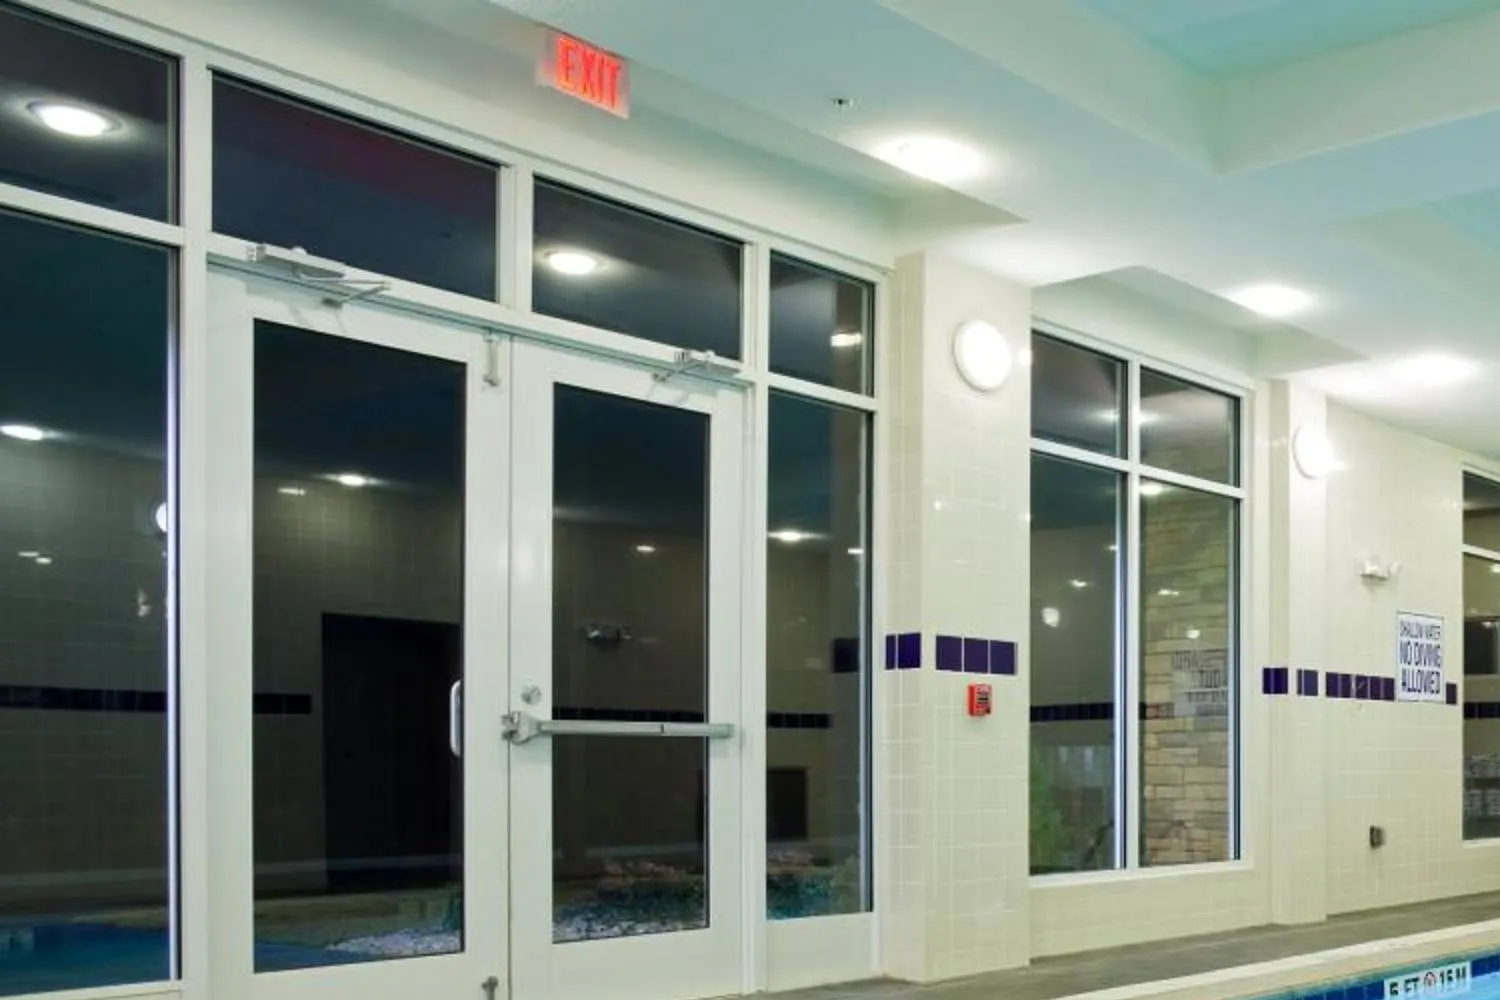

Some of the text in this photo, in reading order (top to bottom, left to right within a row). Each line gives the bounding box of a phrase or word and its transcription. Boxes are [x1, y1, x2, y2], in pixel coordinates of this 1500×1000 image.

[559, 38, 620, 110] EXIT
[1399, 640, 1441, 669] NO DIVING
[1401, 669, 1441, 694] ALLOWED
